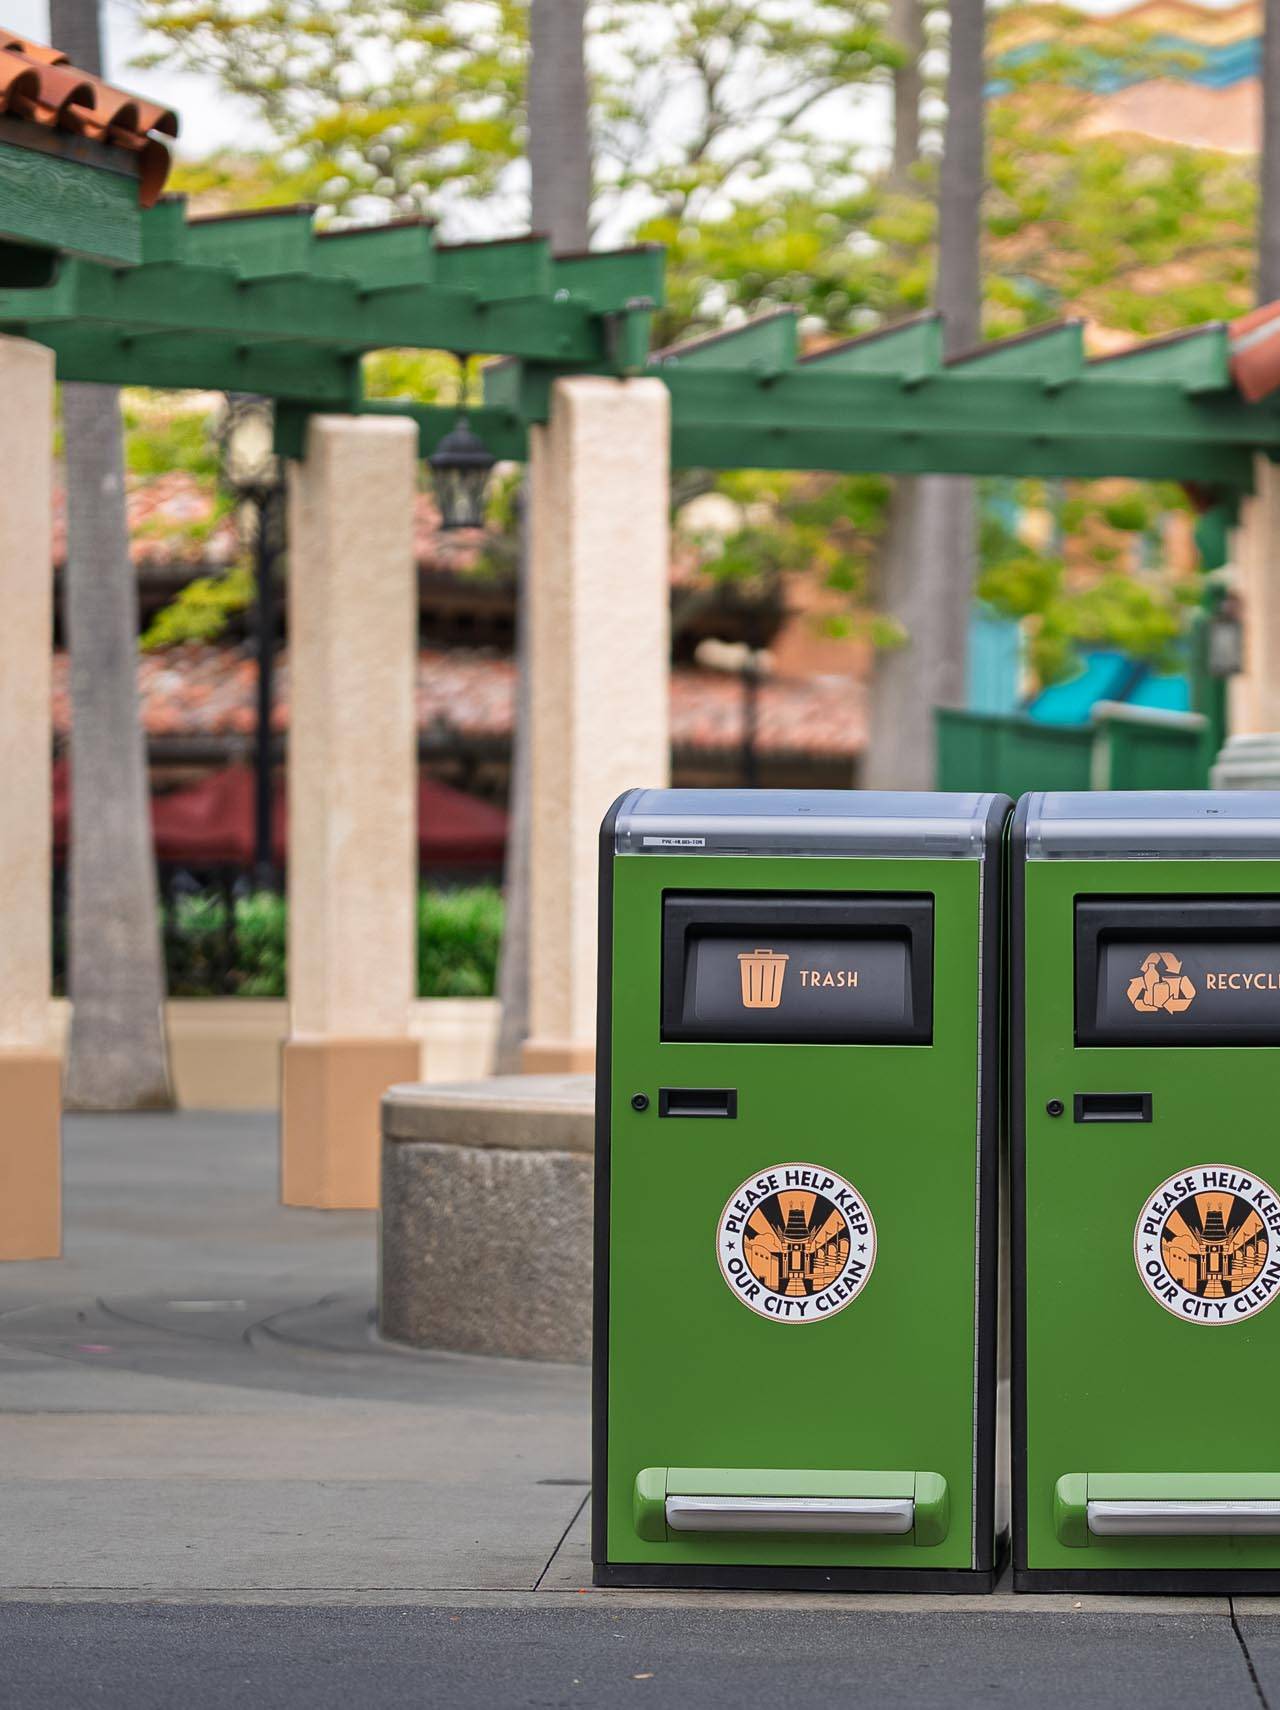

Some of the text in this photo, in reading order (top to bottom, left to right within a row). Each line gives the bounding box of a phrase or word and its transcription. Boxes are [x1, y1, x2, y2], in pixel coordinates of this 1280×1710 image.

[799, 970, 859, 988] TRASH
[725, 1170, 869, 1236] PLEASE HELP KEEP
[1143, 1176, 1197, 1236] PLEASE
[1202, 1171, 1252, 1193] HELP
[727, 1257, 867, 1317] OUR CITY CLEAN
[1145, 1260, 1180, 1304] OUR
[1182, 1297, 1228, 1319] CITY
